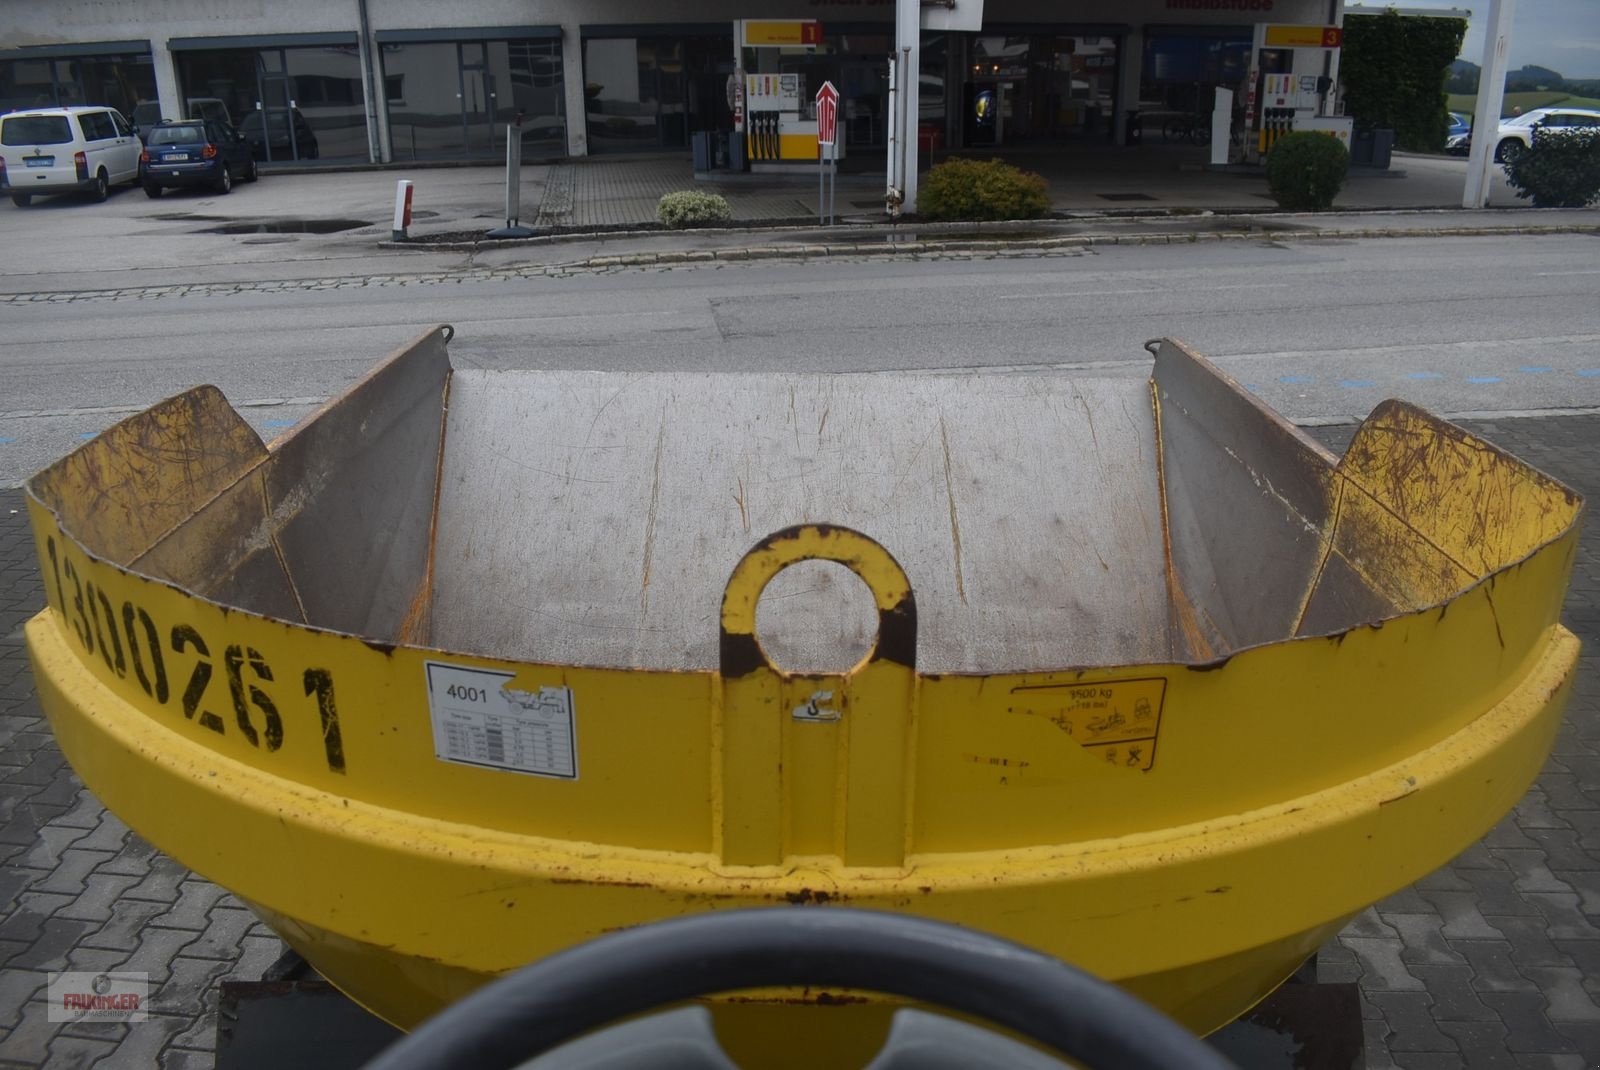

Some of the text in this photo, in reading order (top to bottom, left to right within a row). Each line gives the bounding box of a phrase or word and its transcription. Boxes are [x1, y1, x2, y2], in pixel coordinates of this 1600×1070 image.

[807, 26, 816, 41] 1
[1327, 31, 1337, 45] 3
[46, 535, 346, 775] 1300261
[447, 684, 487, 703] 4001
[1099, 687, 1112, 699] kg
